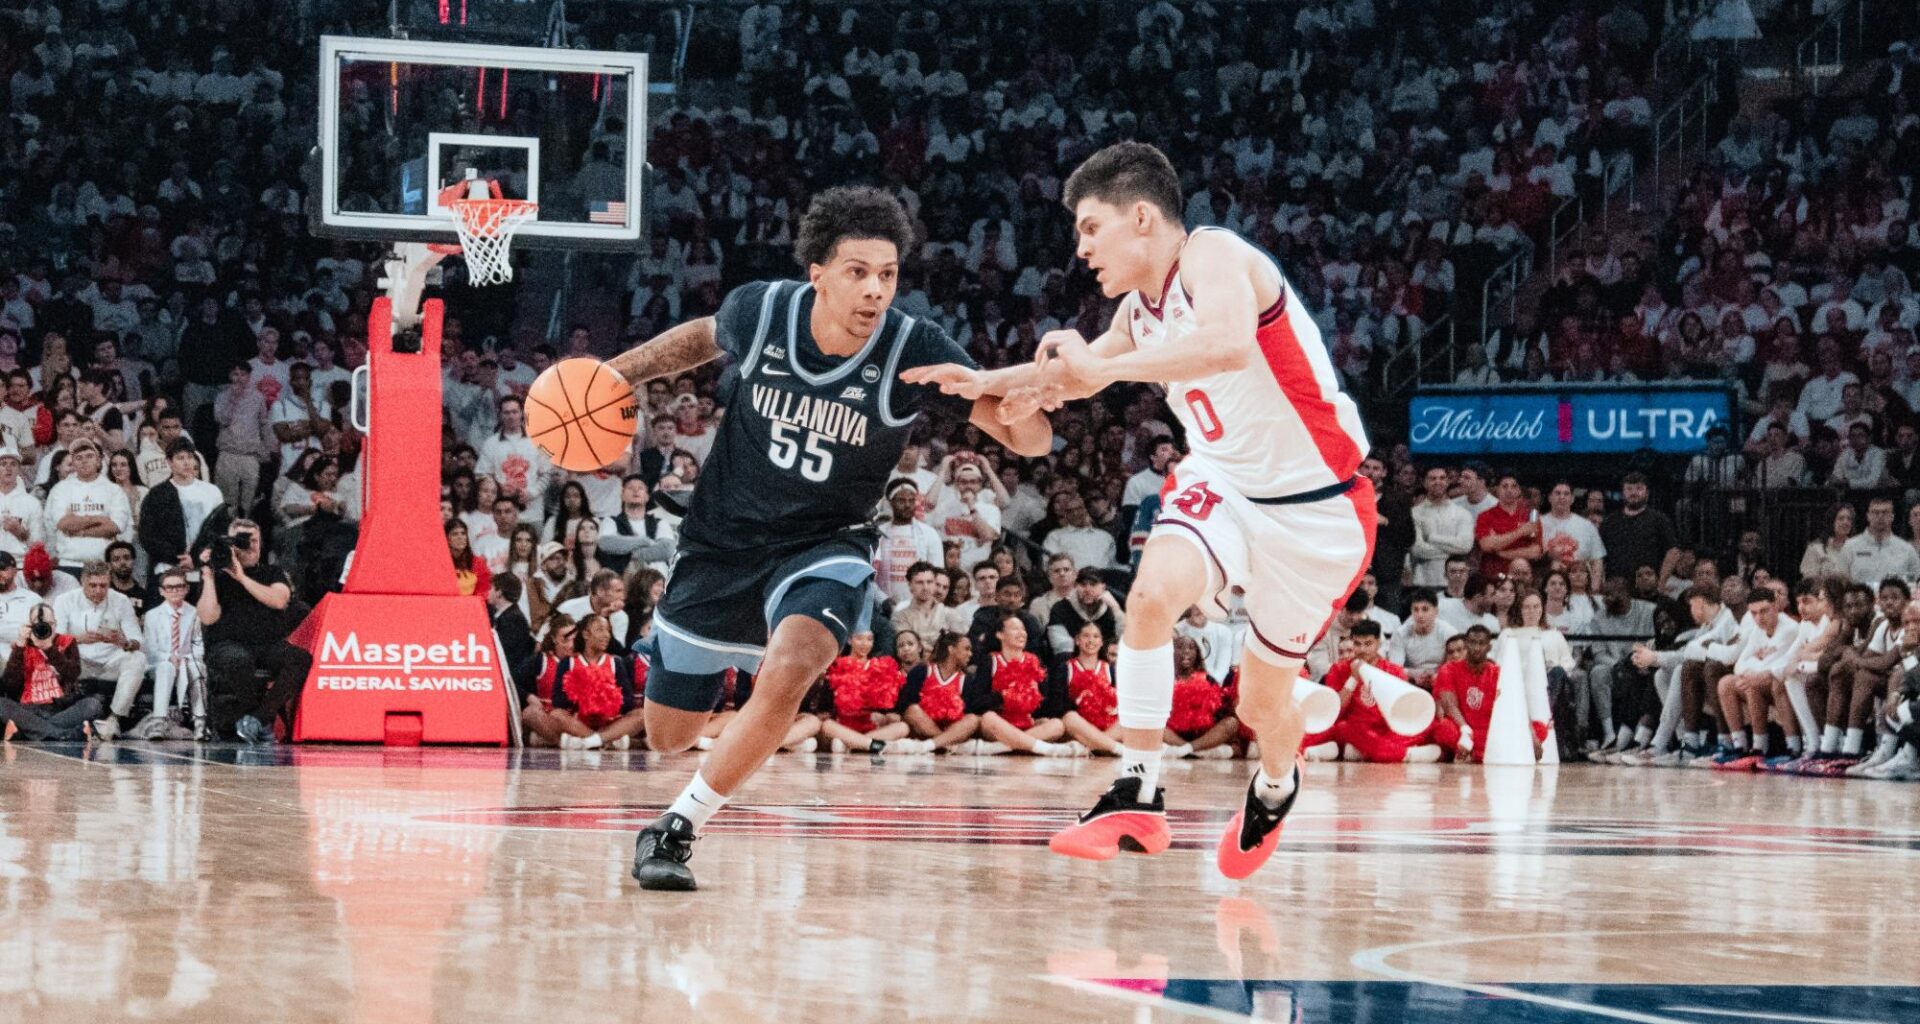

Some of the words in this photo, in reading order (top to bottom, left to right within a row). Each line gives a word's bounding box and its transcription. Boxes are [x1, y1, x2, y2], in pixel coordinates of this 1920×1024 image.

[753, 384, 868, 447] VILLANOVA
[1185, 389, 1224, 442] 0
[1411, 406, 1545, 444] Michelob
[1587, 408, 1717, 438] ULTRA
[768, 419, 837, 481] 55
[320, 631, 491, 674] Maspeth
[318, 677, 406, 690] FEDERAL
[408, 677, 493, 691] SAVINGS
